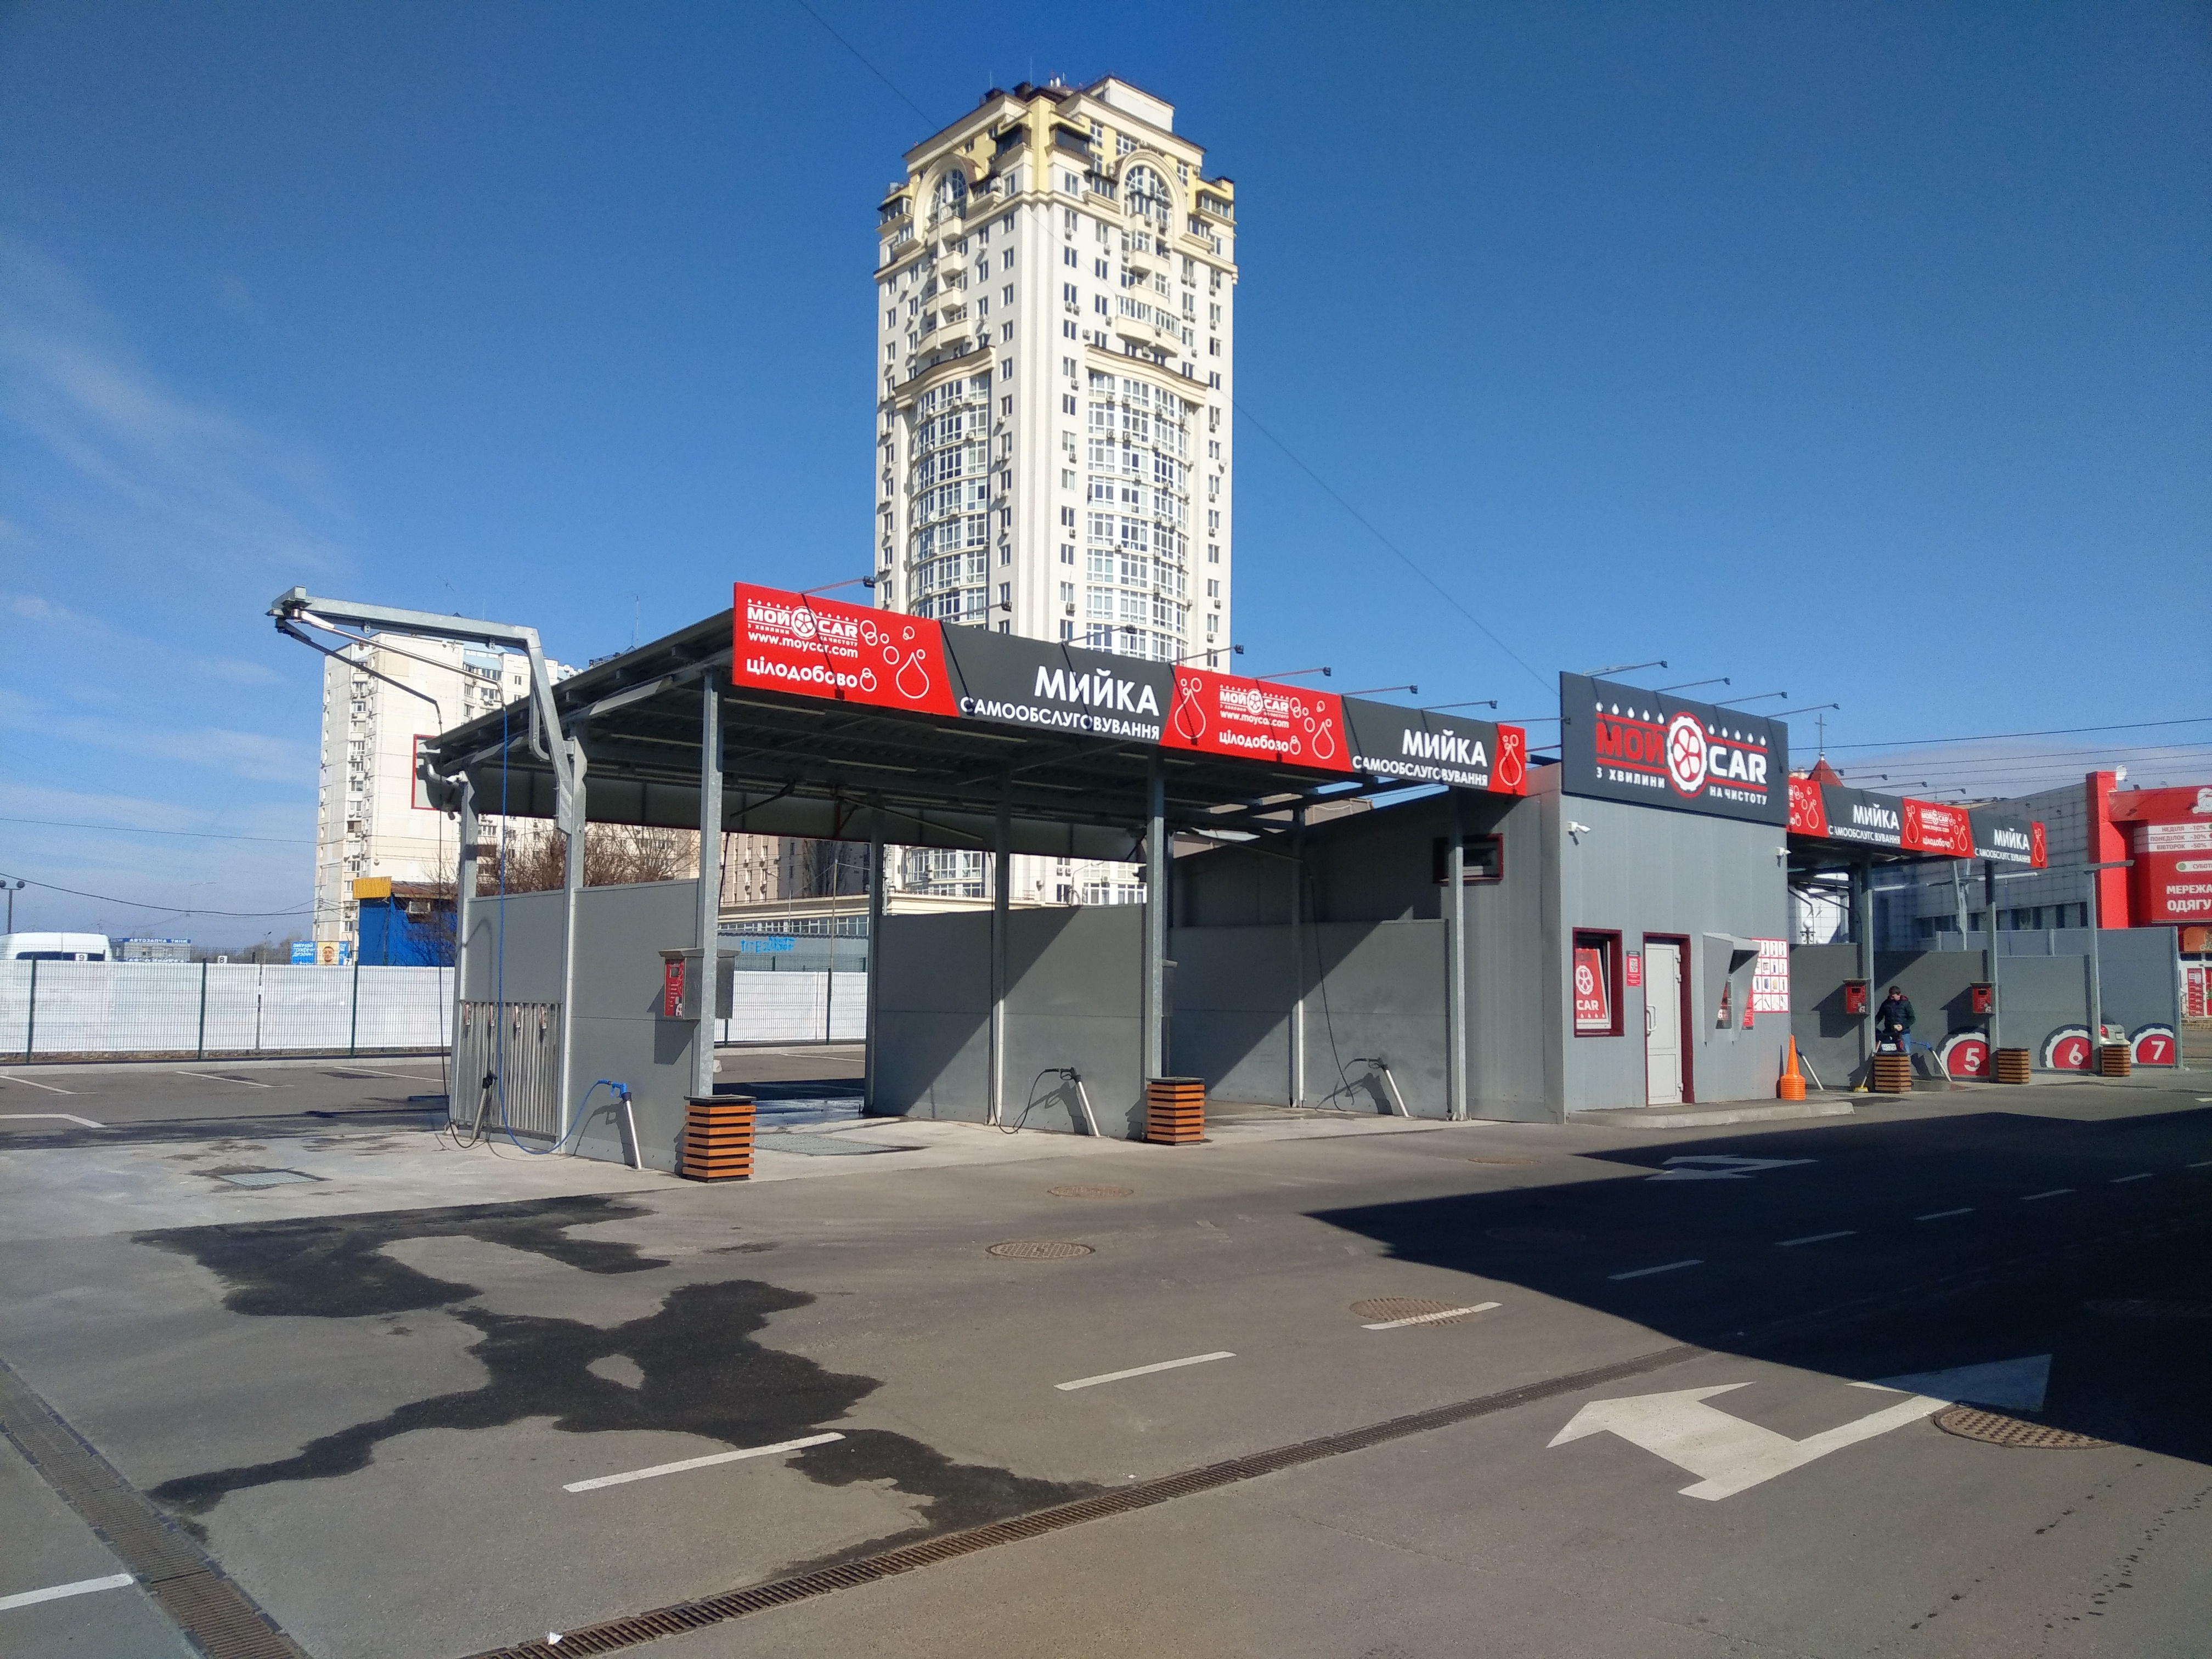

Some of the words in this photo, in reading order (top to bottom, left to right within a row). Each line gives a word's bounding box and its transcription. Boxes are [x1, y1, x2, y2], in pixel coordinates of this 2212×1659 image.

[747, 607, 790, 625] МОЙ
[819, 620, 857, 638] CAR
[748, 631, 858, 658] www.moycar.com
[828, 637, 857, 647] ЧИСТОТУ
[1034, 665, 1159, 716] МИЙКА
[1220, 691, 1246, 705] МОЙ
[1263, 699, 1289, 712] CAR
[960, 696, 1159, 740] САМООБСЛУГОВУВАННЯ
[1220, 710, 1289, 729] www.moyca.com
[1402, 729, 1488, 768] МИЙКА
[1596, 722, 1665, 764] МОЙ
[1708, 746, 1767, 784] CAR
[1352, 755, 1488, 787] САМООБСЛУГОВУВАННЯ
[1609, 769, 1665, 789] ХВИЛИНИ
[1709, 786, 1723, 798] НА
[1724, 789, 1767, 805] ЧИСТОТУ
[1853, 802, 1900, 830] МИЙКА
[1994, 827, 2030, 851] МИЙКА
[2166, 884, 2212, 895] МЕРЕЖА
[2167, 899, 2211, 912] ОДЯГУ
[1576, 1000, 1599, 1011] CAR
[1963, 1048, 1980, 1071] 5
[2069, 1043, 2083, 1065] 6
[2151, 1041, 2166, 1060] 7
